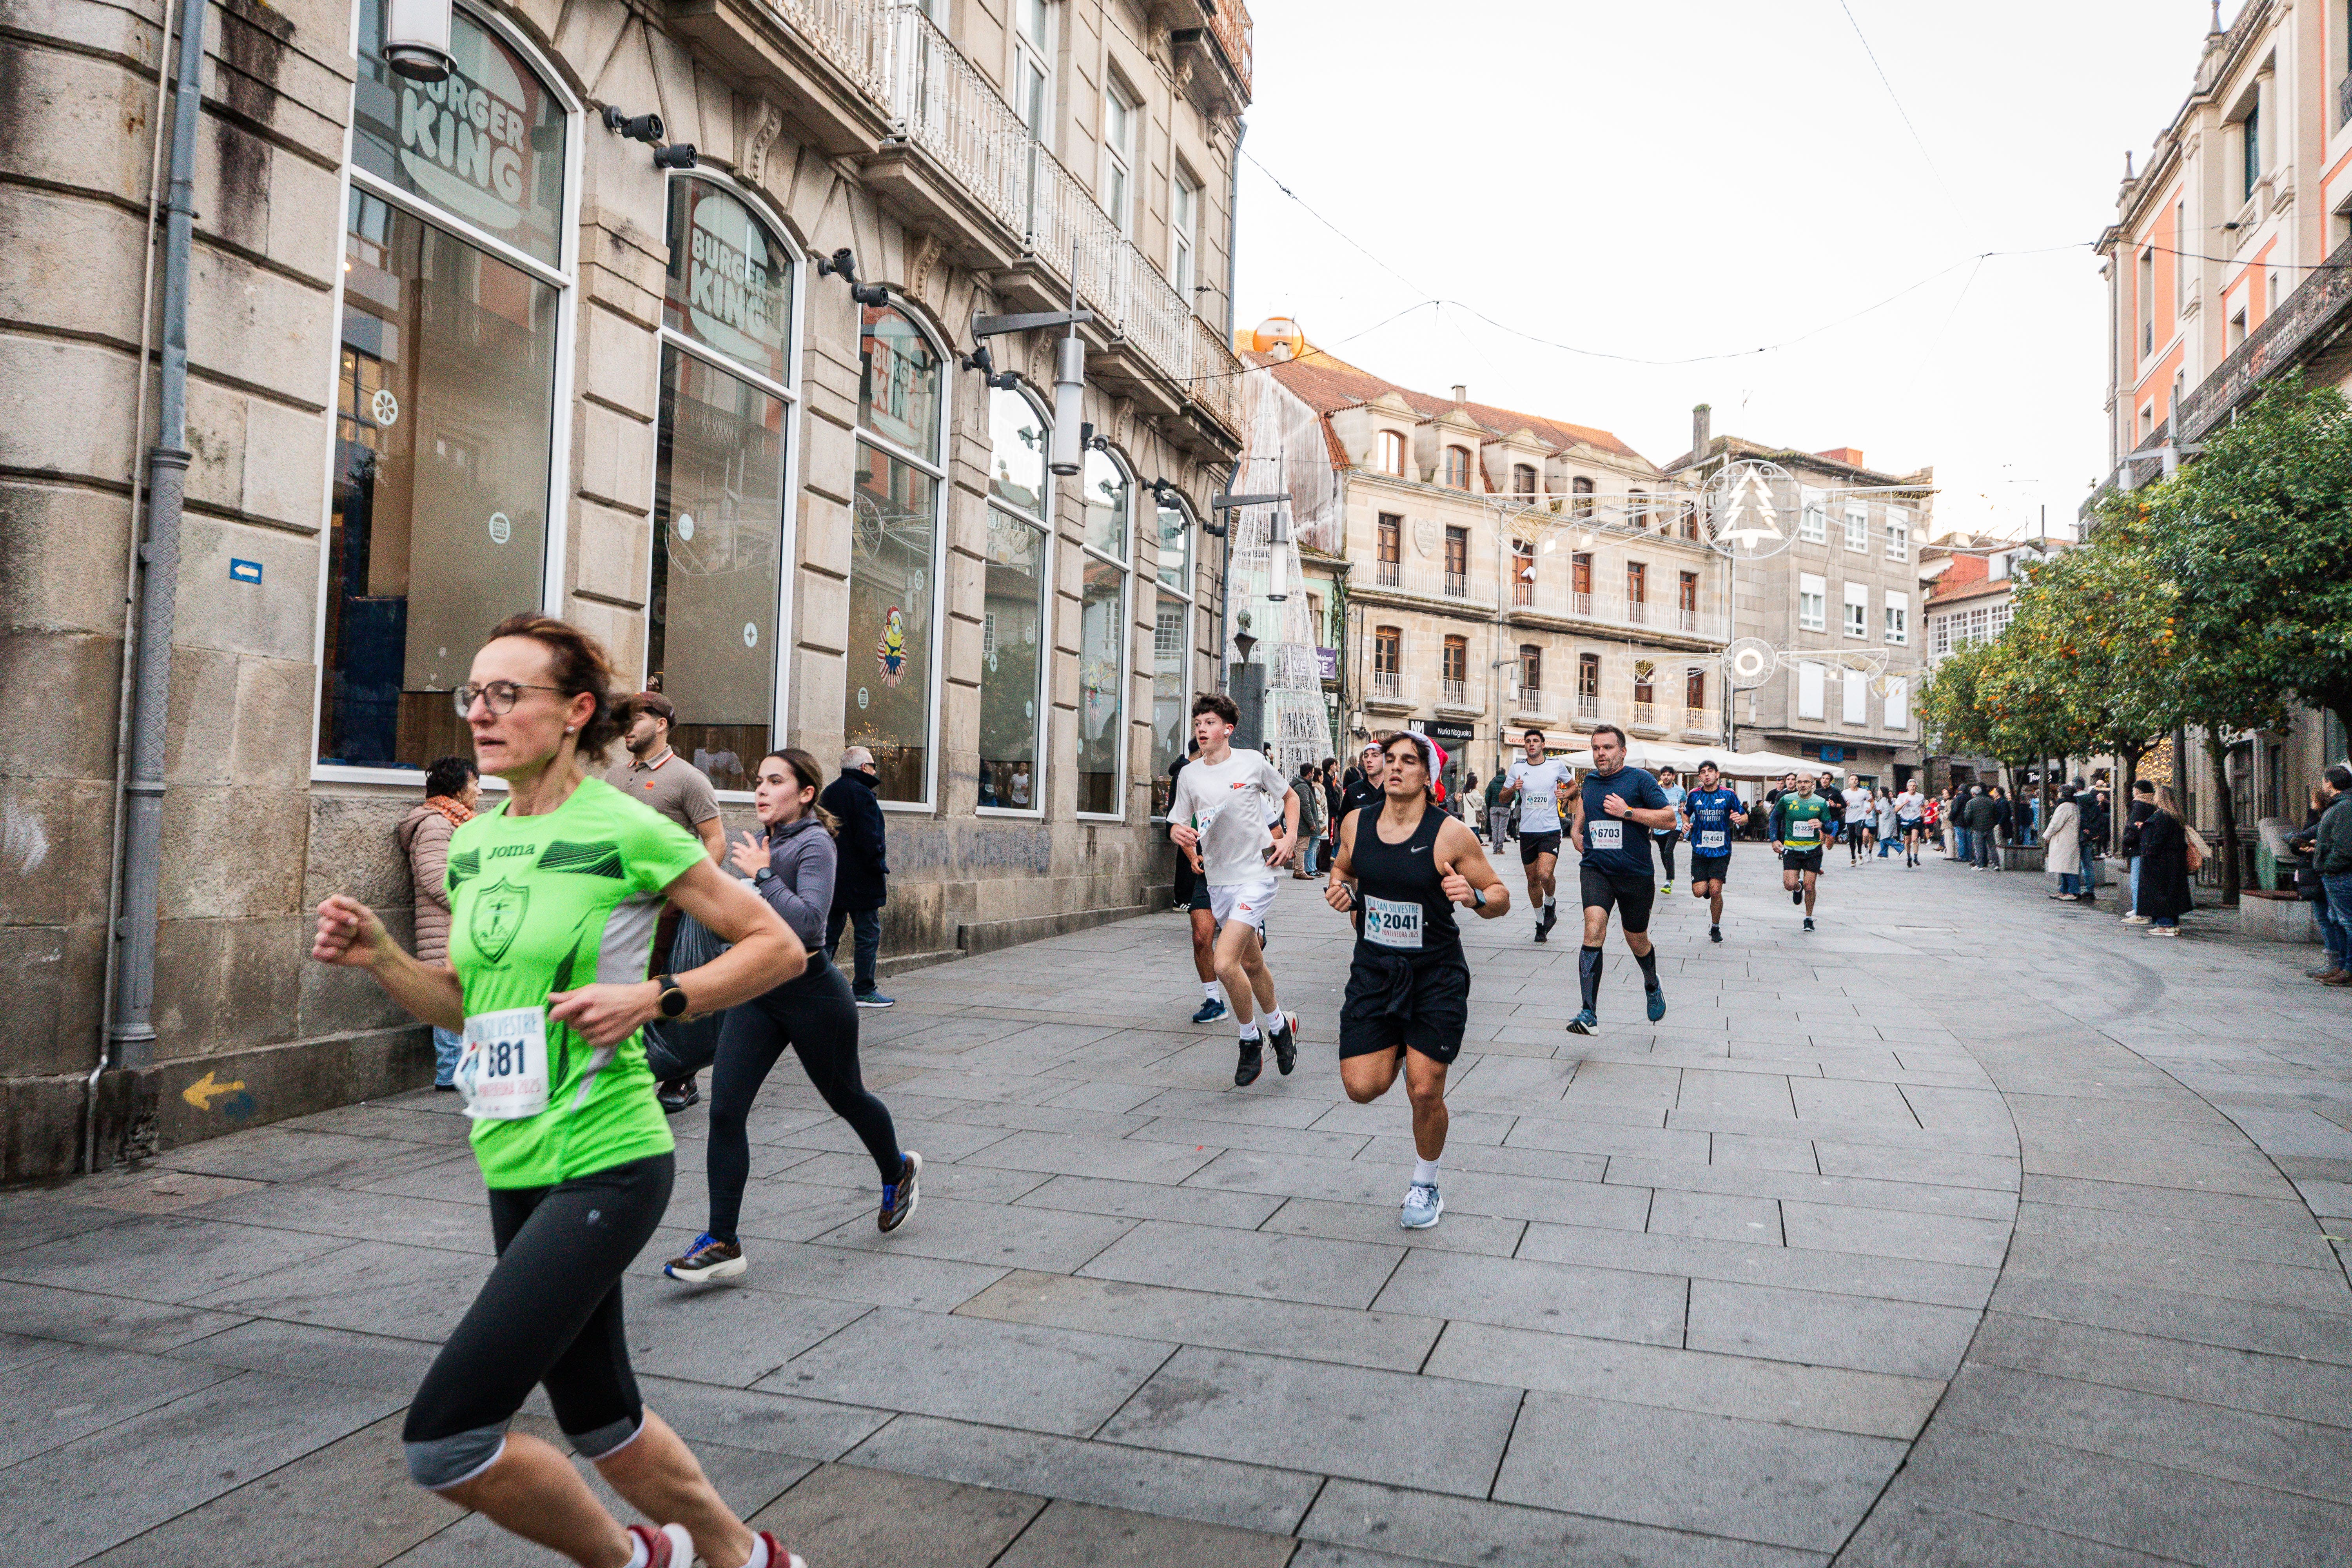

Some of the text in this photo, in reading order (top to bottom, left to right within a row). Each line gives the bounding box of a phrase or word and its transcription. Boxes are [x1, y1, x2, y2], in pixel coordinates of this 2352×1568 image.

[401, 88, 522, 202] KING
[692, 227, 767, 302] BURGER
[690, 260, 766, 338] KING
[1451, 729, 1472, 738] Nogueira
[1598, 828, 1620, 838] 6703
[1377, 901, 1387, 911] SAN
[1389, 903, 1419, 913] SILVESTRE
[1383, 913, 1417, 930] 2041
